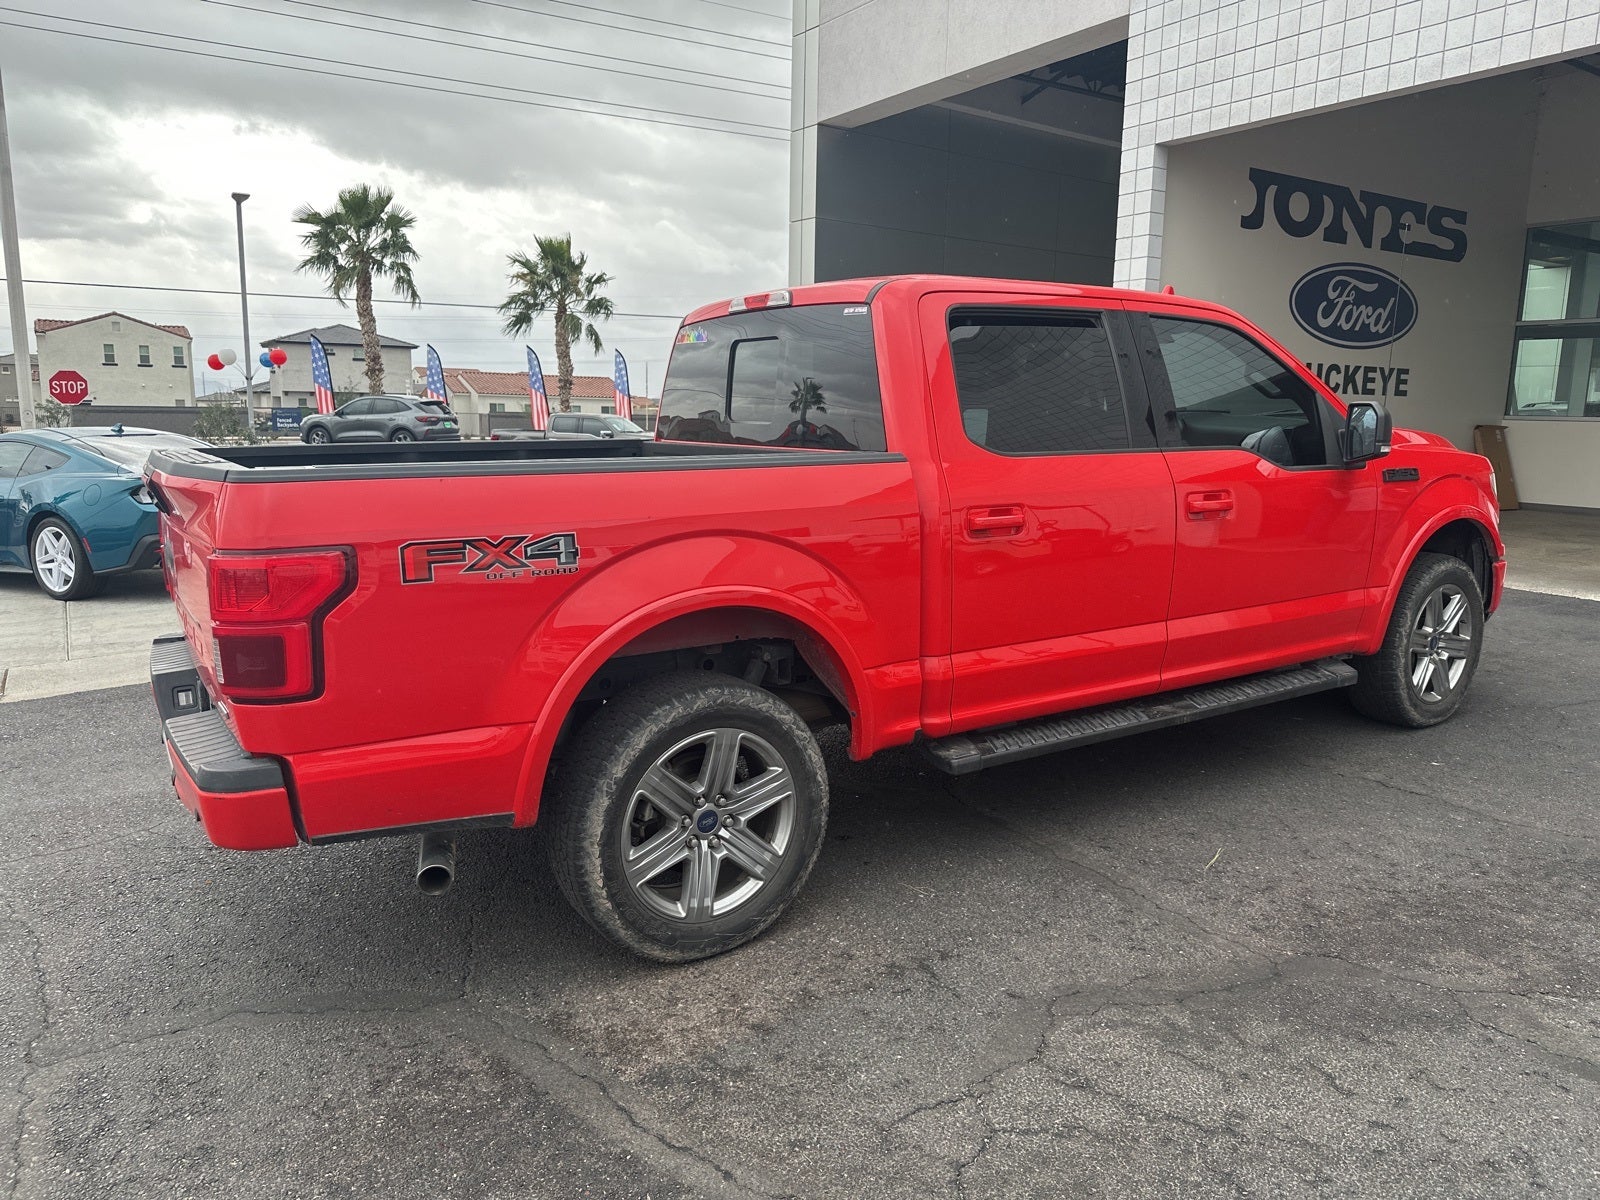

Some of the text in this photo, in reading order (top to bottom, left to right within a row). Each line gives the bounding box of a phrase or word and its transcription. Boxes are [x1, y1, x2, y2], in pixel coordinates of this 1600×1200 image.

[1240, 166, 1468, 263] JONES
[1317, 275, 1395, 334] Ford
[51, 380, 86, 394] STOP
[1306, 362, 1410, 397] CKEYE
[398, 532, 580, 585] FX4
[486, 566, 579, 580] OFF ROAD
